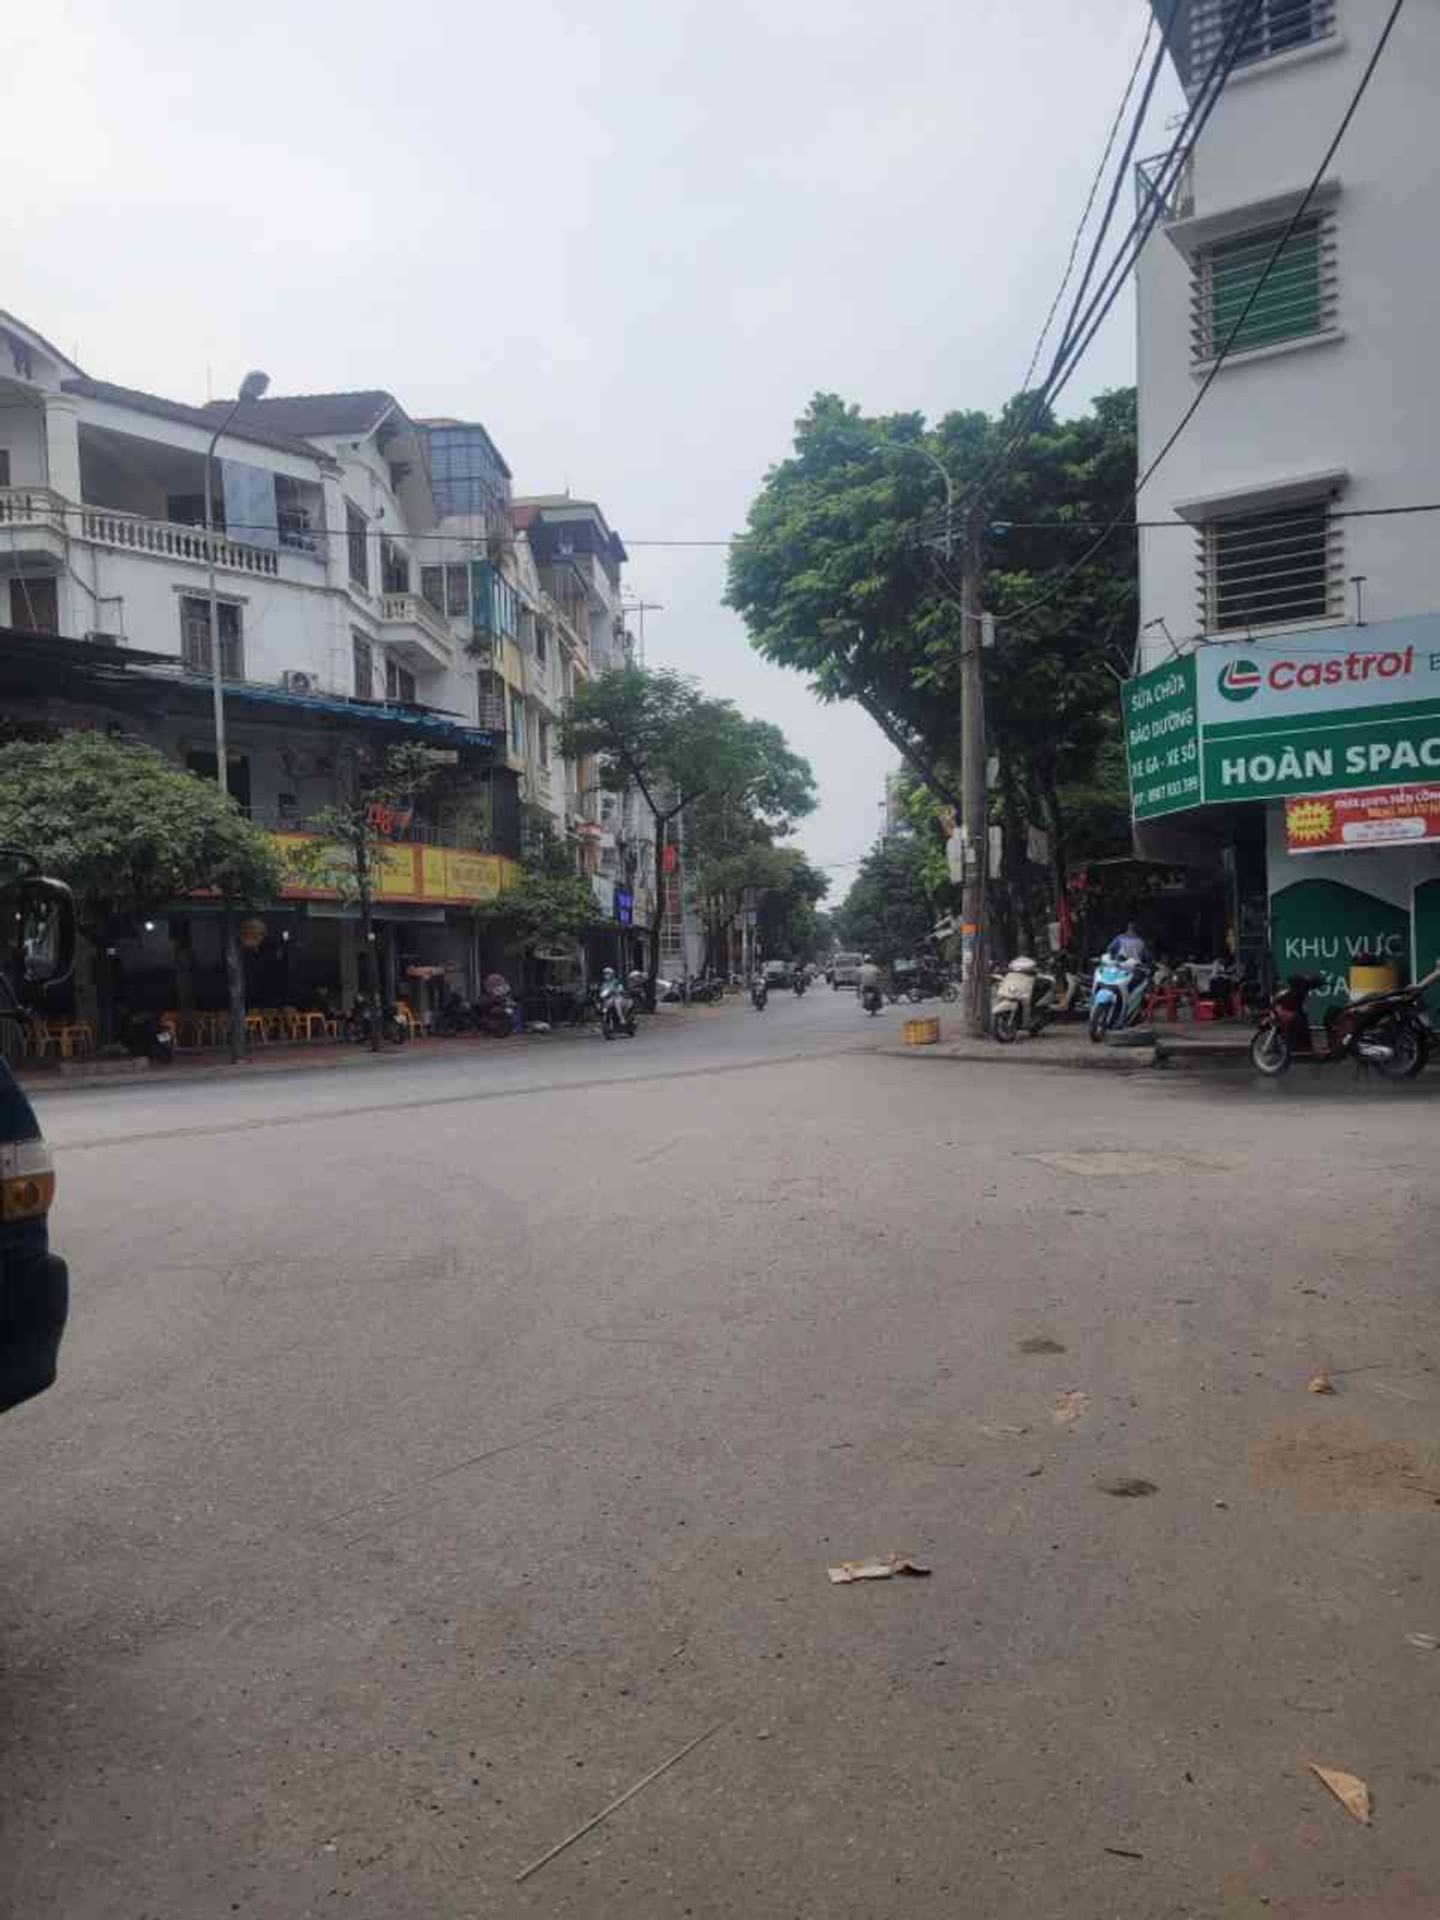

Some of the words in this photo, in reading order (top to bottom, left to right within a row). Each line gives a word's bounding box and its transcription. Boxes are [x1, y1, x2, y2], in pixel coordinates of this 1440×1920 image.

[1268, 645, 1414, 691] Castrol
[1166, 748, 1180, 768] XE
[1221, 747, 1333, 786] HOÀN
[1285, 936, 1339, 959] KHU
